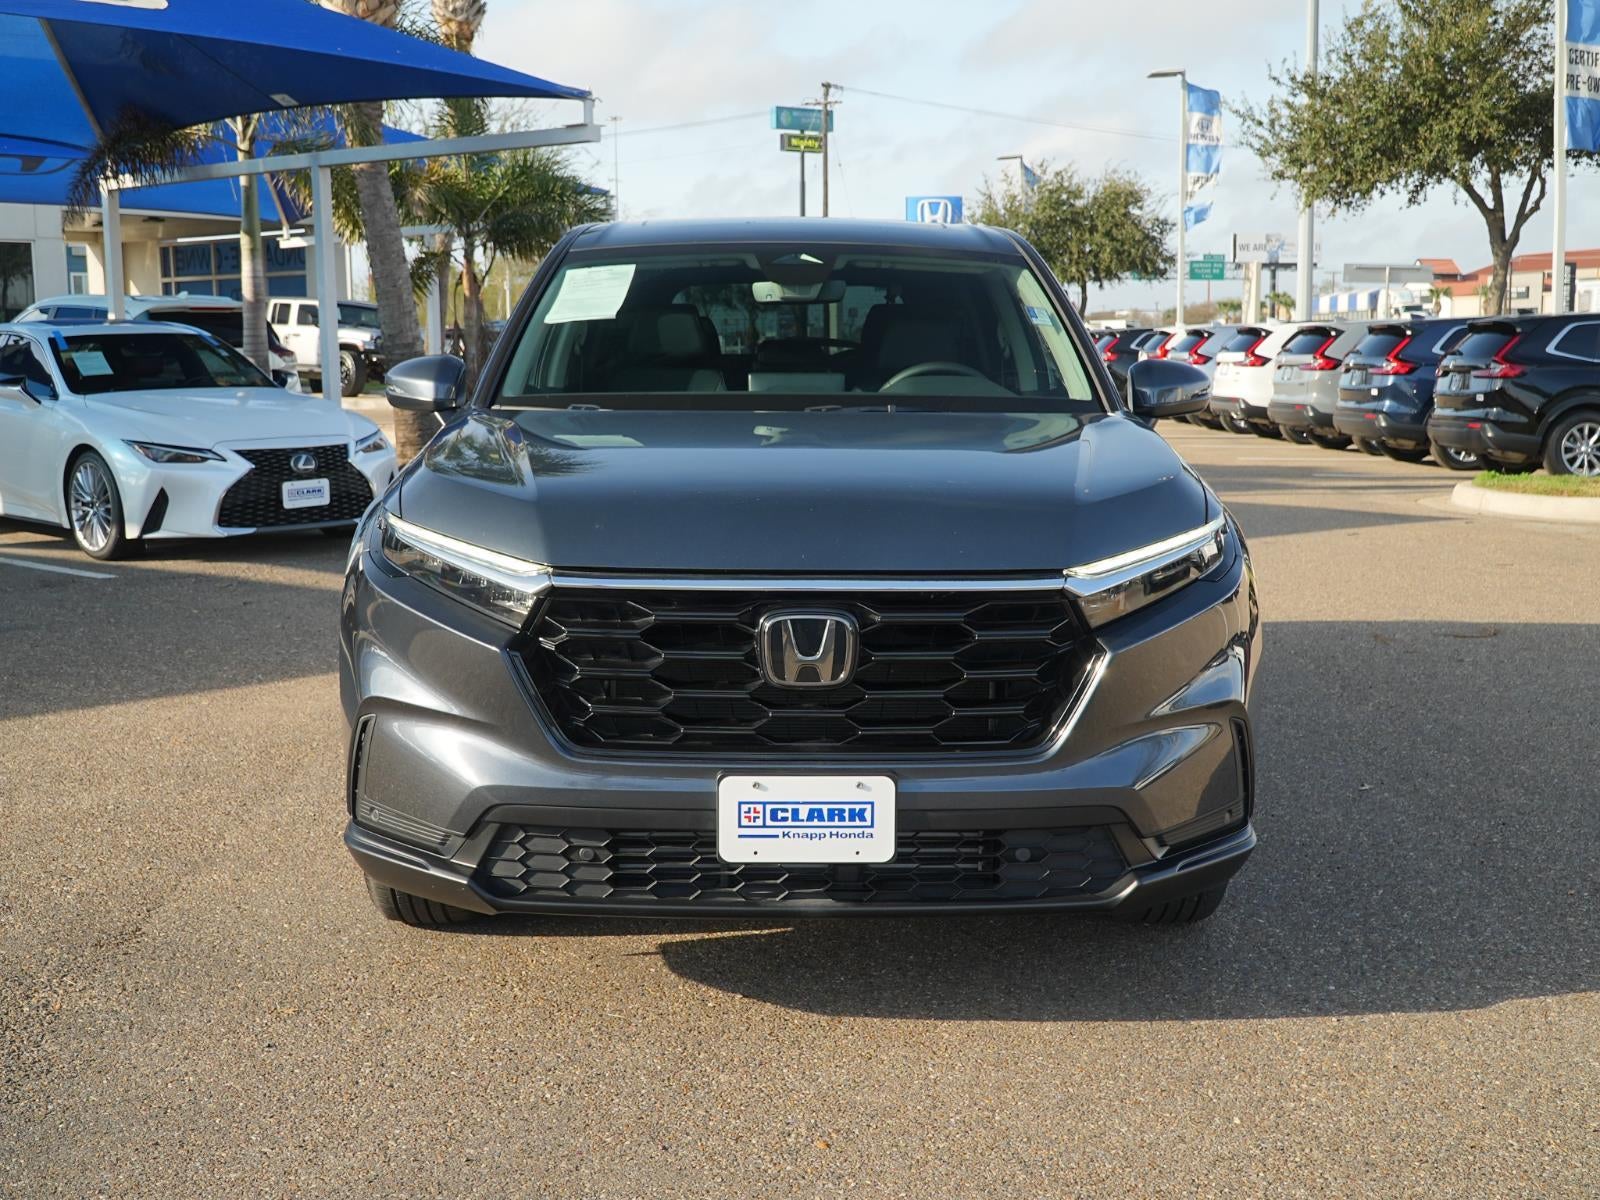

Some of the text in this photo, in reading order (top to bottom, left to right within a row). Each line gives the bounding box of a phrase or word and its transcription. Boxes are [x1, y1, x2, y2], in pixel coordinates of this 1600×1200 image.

[769, 807, 868, 823] CLARK
[782, 830, 874, 841] Knapp Honda
